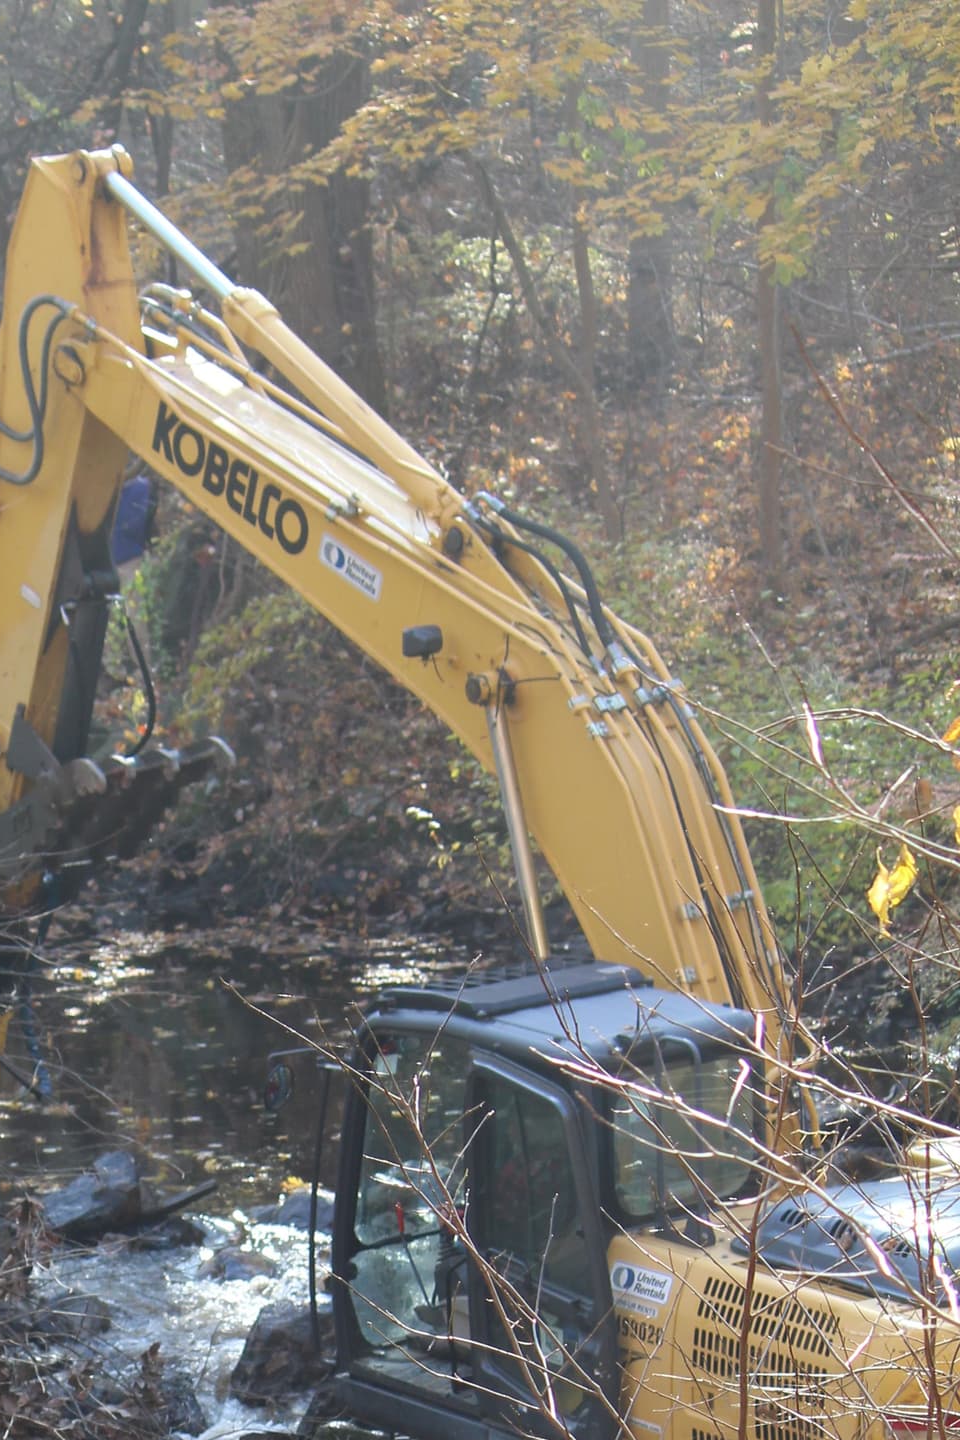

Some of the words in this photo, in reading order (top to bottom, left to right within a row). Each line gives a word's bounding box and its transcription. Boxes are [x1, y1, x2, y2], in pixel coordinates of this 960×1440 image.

[152, 400, 309, 555] KOBELCO
[345, 565, 376, 595] Rentals
[346, 556, 377, 582] United
[633, 1283, 666, 1301] Rentals
[636, 1271, 668, 1288] United
